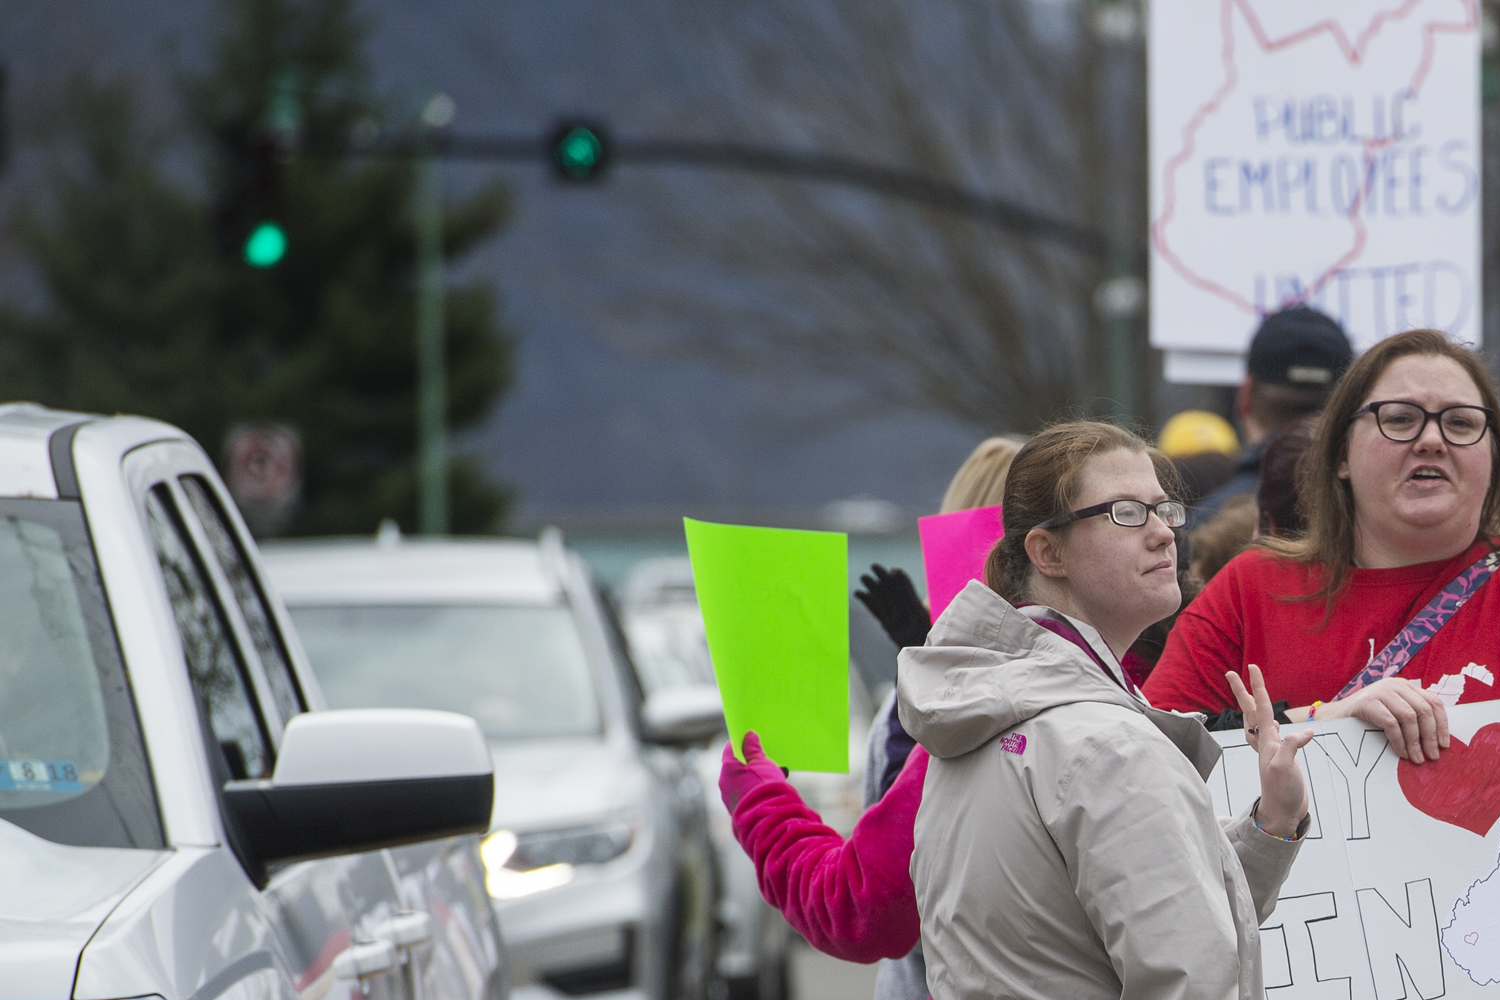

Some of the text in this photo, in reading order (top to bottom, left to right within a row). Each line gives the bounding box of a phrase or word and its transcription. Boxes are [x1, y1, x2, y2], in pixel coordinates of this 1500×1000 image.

[1252, 87, 1422, 147] PUBLIC
[1203, 138, 1479, 219] EMPLOYEES
[22, 762, 36, 780] 8
[48, 763, 78, 781] 18
